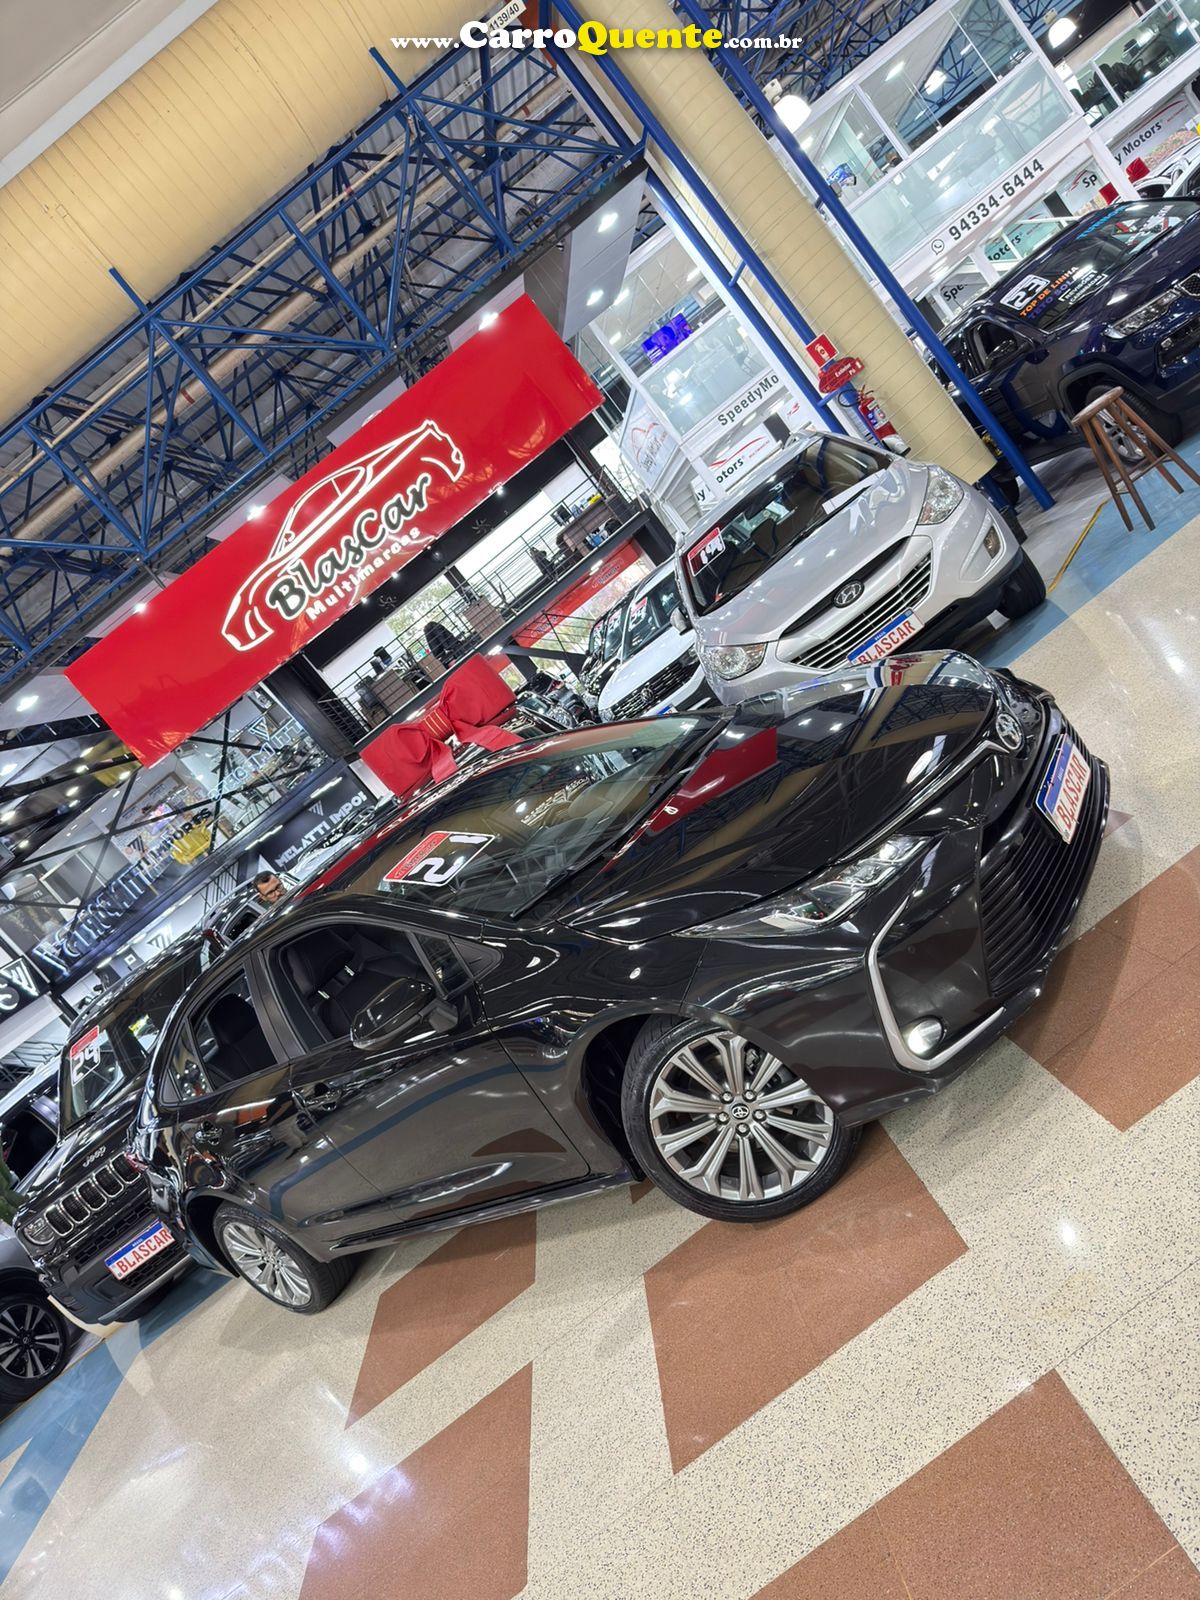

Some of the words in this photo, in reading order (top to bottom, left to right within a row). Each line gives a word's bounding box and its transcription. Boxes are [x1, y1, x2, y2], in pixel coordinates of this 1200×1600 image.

[489, 3, 520, 31] 1139/40
[1122, 121, 1163, 156] Motors
[947, 158, 1045, 241] 94334-6444
[1007, 277, 1047, 306] 23
[1019, 300, 1038, 316] TOP
[1038, 288, 1051, 300] DE
[1050, 265, 1079, 289] LINHA
[1028, 296, 1053, 320] TETO
[717, 374, 779, 426] SpeedyMo
[264, 472, 433, 621] BlasCar
[697, 536, 724, 565] 14
[306, 526, 421, 621] Multimarcas
[858, 620, 916, 664] BLASCAR
[1056, 753, 1088, 830] BLASCAR
[274, 820, 331, 867] MELATTI
[407, 839, 488, 882] 21
[73, 1043, 97, 1082] 24
[83, 1145, 106, 1167] Jeep
[116, 1228, 172, 1273] BLASCAR
